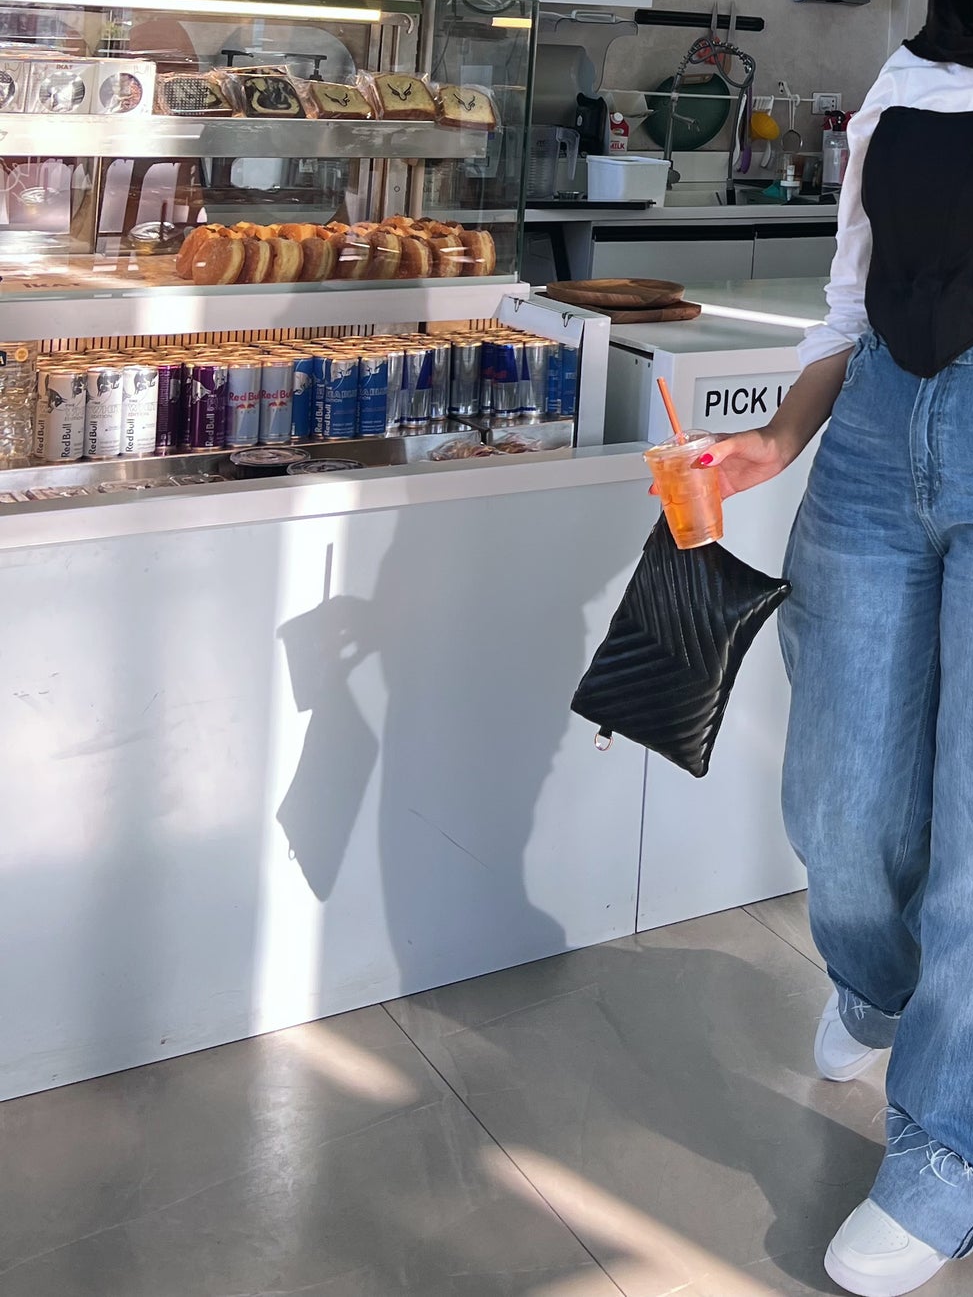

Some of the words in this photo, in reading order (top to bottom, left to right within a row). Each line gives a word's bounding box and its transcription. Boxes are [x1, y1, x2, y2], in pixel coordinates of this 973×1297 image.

[229, 392, 246, 401] Red
[261, 390, 278, 399] Red
[705, 387, 768, 417] PICK
[315, 401, 323, 416] Bull
[90, 421, 98, 438] Bull
[126, 418, 135, 434] Bull
[206, 414, 215, 429] Bull
[314, 418, 323, 433] Red
[323, 420, 331, 436] Red
[63, 423, 72, 440] Bull
[205, 430, 214, 447] Red
[61, 440, 71, 458] Red
[89, 440, 97, 455] Red
[126, 436, 134, 452] Red
